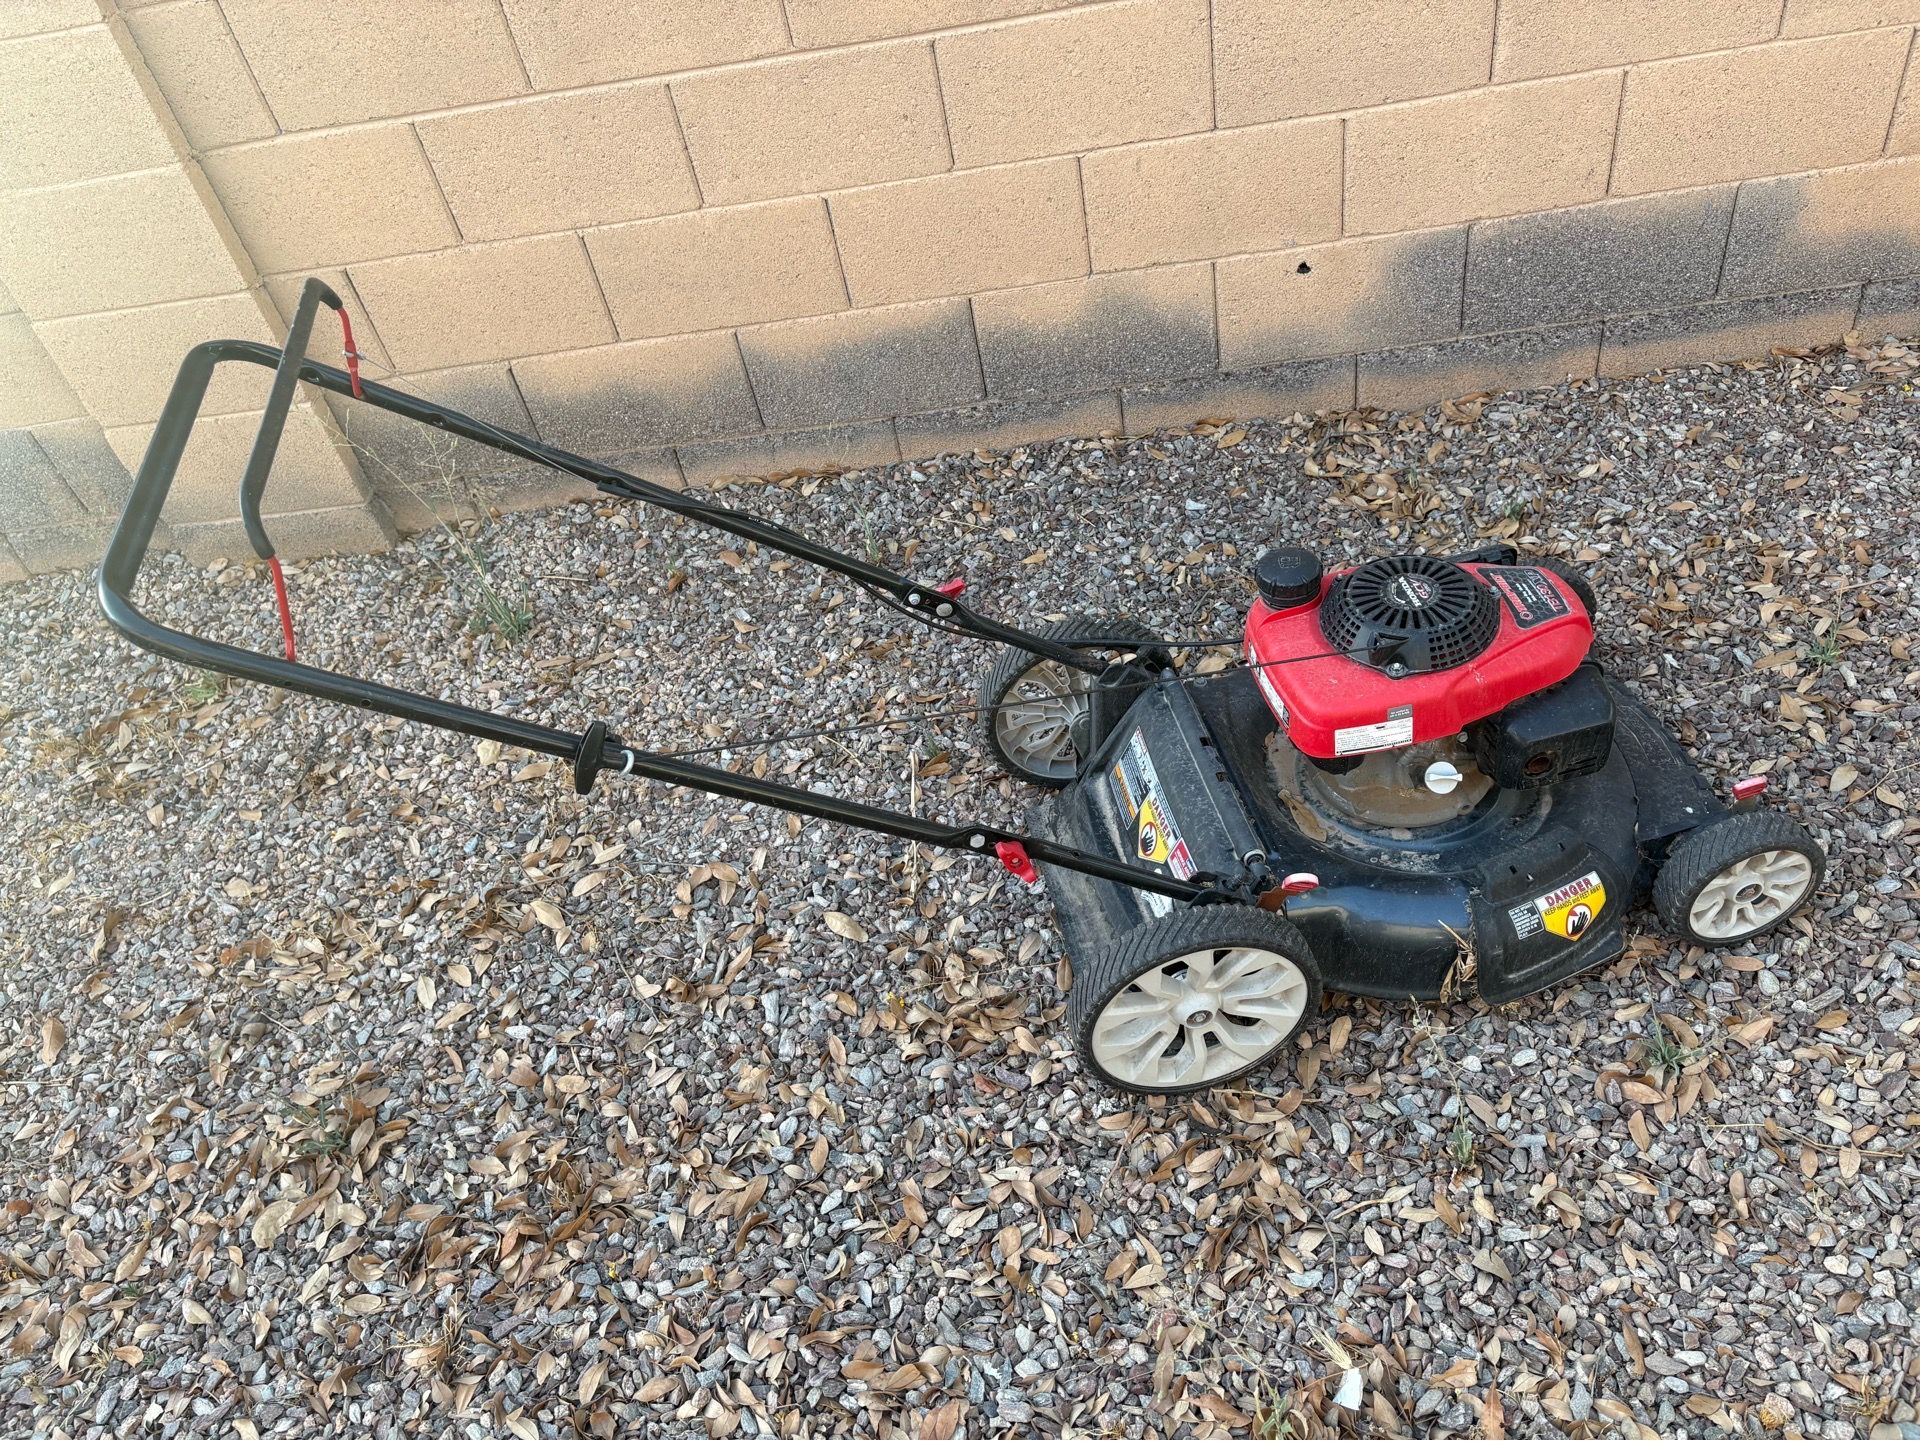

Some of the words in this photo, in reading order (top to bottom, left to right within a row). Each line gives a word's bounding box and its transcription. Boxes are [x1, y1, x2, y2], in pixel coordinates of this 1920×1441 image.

[1399, 576, 1422, 607] HONDA
[1152, 797, 1172, 840] DANGER
[1544, 906, 1556, 916] KEEP
[1557, 899, 1573, 911] HANDS
[1580, 892, 1590, 901] FEET
[1590, 885, 1601, 895] AWAY
[1545, 878, 1593, 907] DANGER
